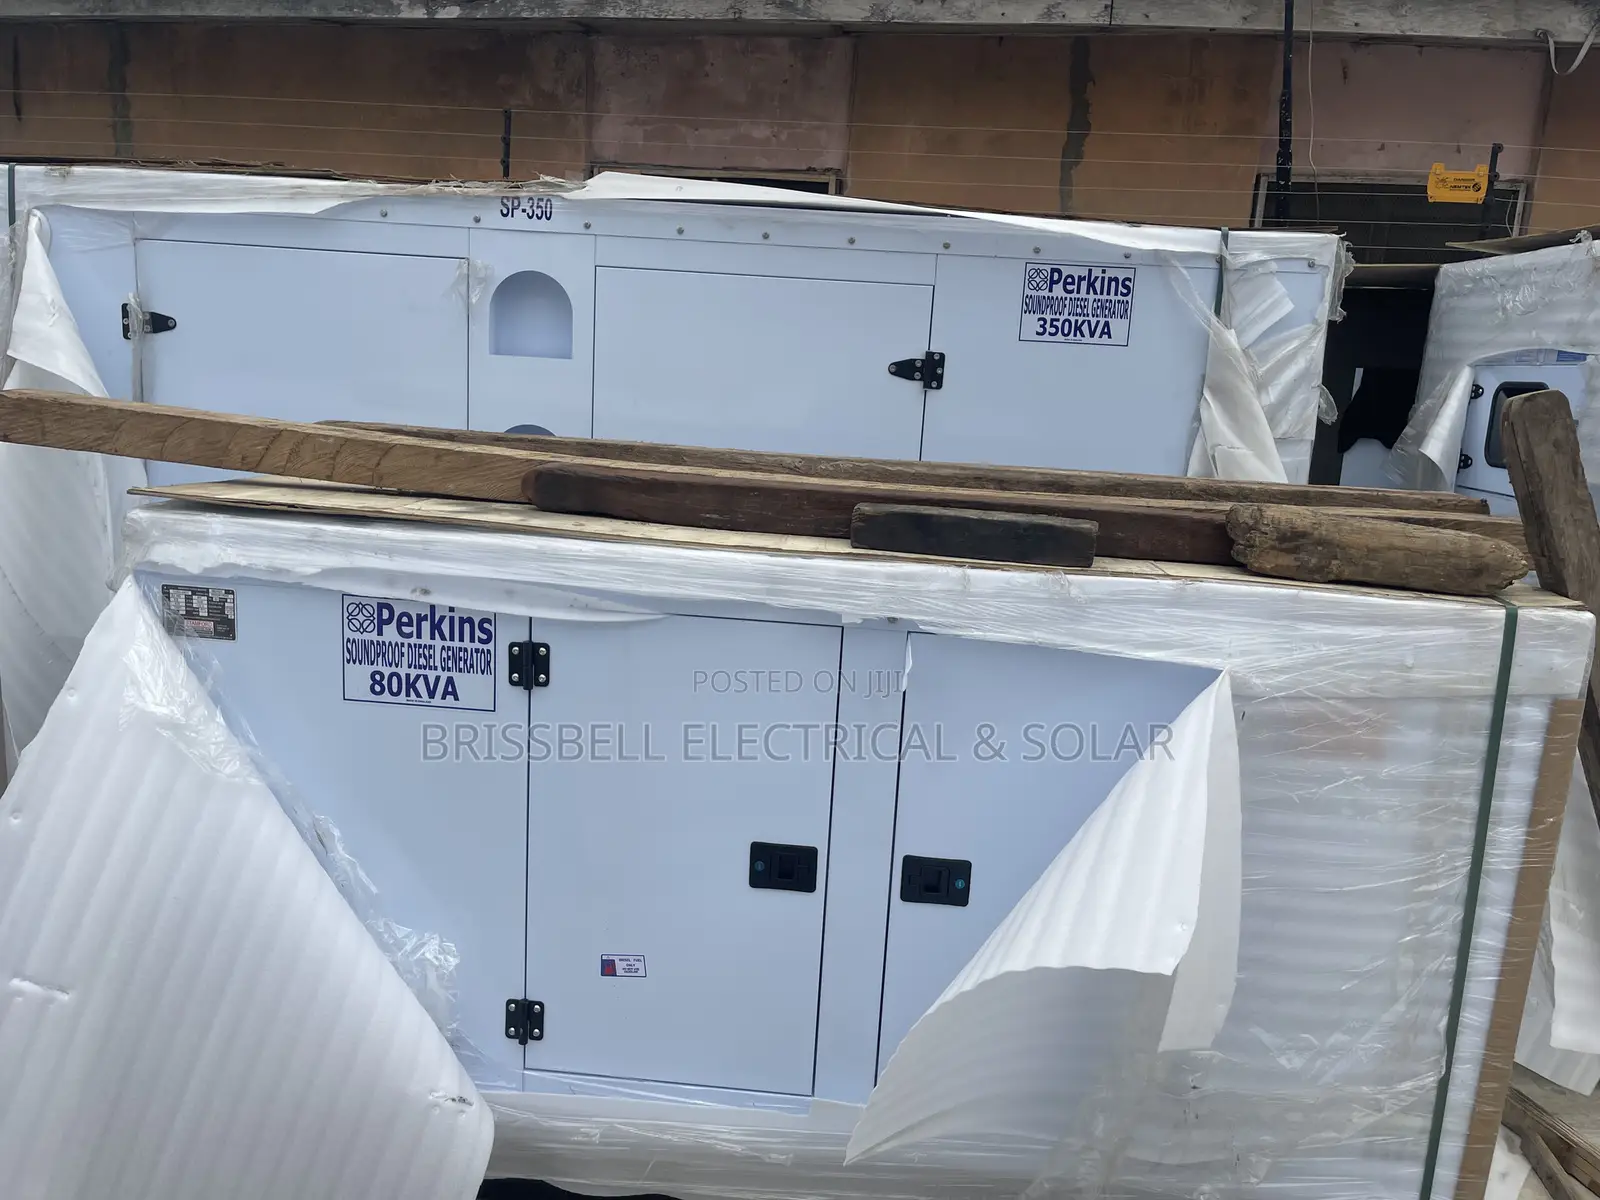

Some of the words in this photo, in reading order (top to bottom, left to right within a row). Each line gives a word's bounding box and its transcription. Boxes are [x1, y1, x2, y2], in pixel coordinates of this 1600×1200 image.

[500, 195, 553, 221] SP-350
[1048, 267, 1133, 297] Perkins
[1024, 294, 1068, 316] SOUNDPROOF
[1068, 297, 1090, 317] DIESEL
[1091, 298, 1129, 320] GENERATOR
[1035, 317, 1112, 339] 350KVA
[376, 601, 494, 645] Perkins
[345, 637, 405, 669] SOUNDPROOF
[407, 642, 438, 671] DIESEL
[440, 645, 493, 676] GENERATOR
[369, 670, 460, 701] 80KVA
